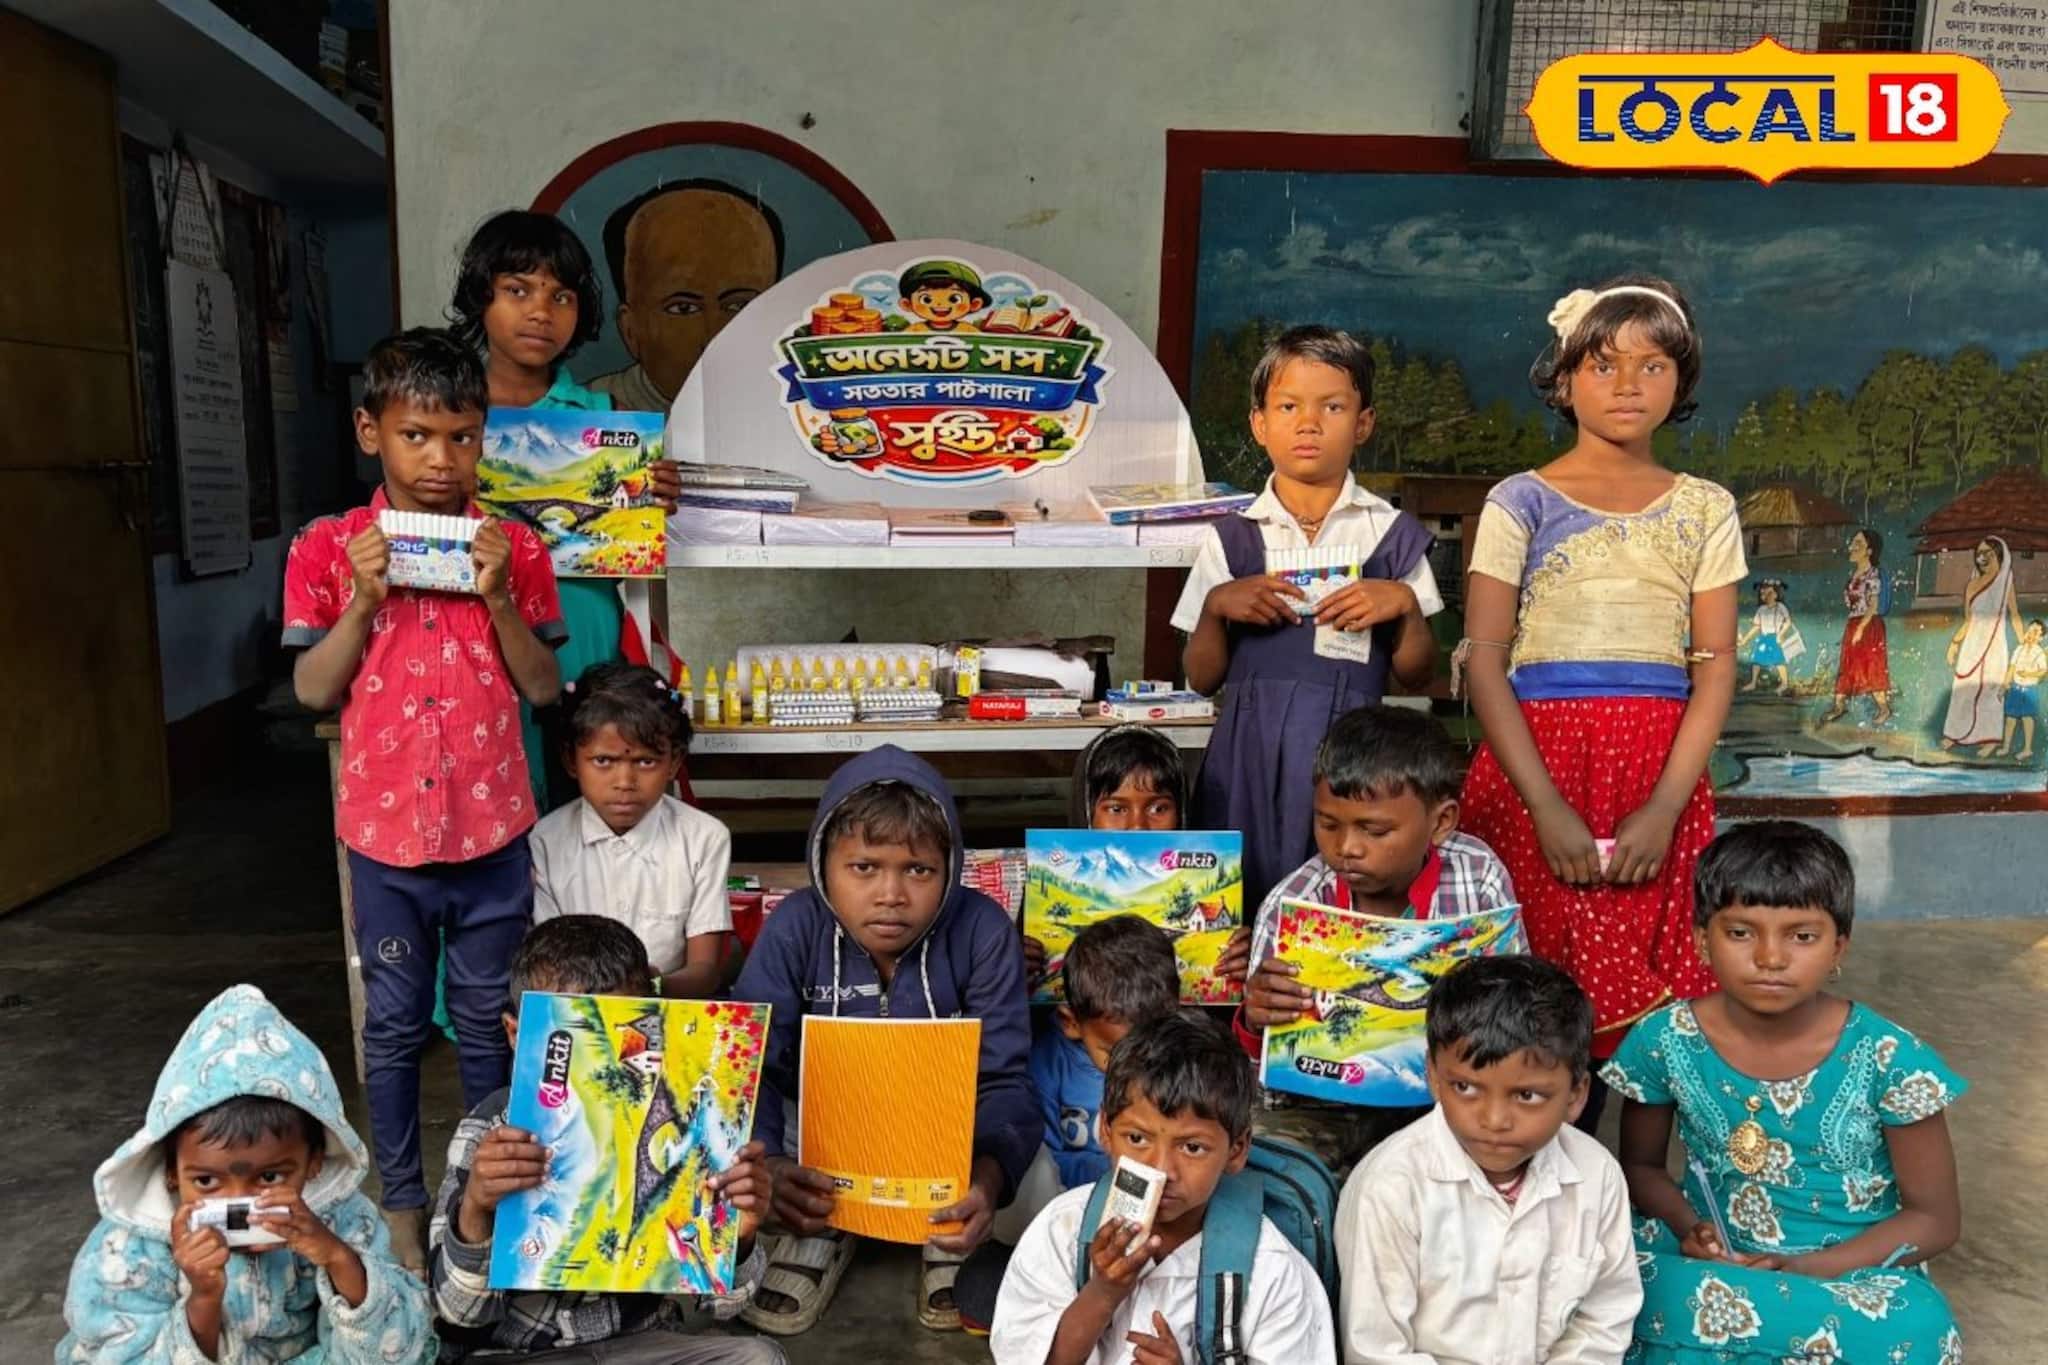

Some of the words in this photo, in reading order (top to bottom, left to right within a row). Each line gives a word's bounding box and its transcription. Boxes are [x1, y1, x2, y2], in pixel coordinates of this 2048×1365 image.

[840, 381, 931, 401] সততার
[935, 378, 1037, 403] পাঠশালা
[582, 428, 637, 448] Ankit
[982, 702, 1022, 710] NATARAJ
[1161, 850, 1216, 869] Ankit
[540, 1034, 572, 1105] Ankit
[1299, 1055, 1364, 1081] Ankit
